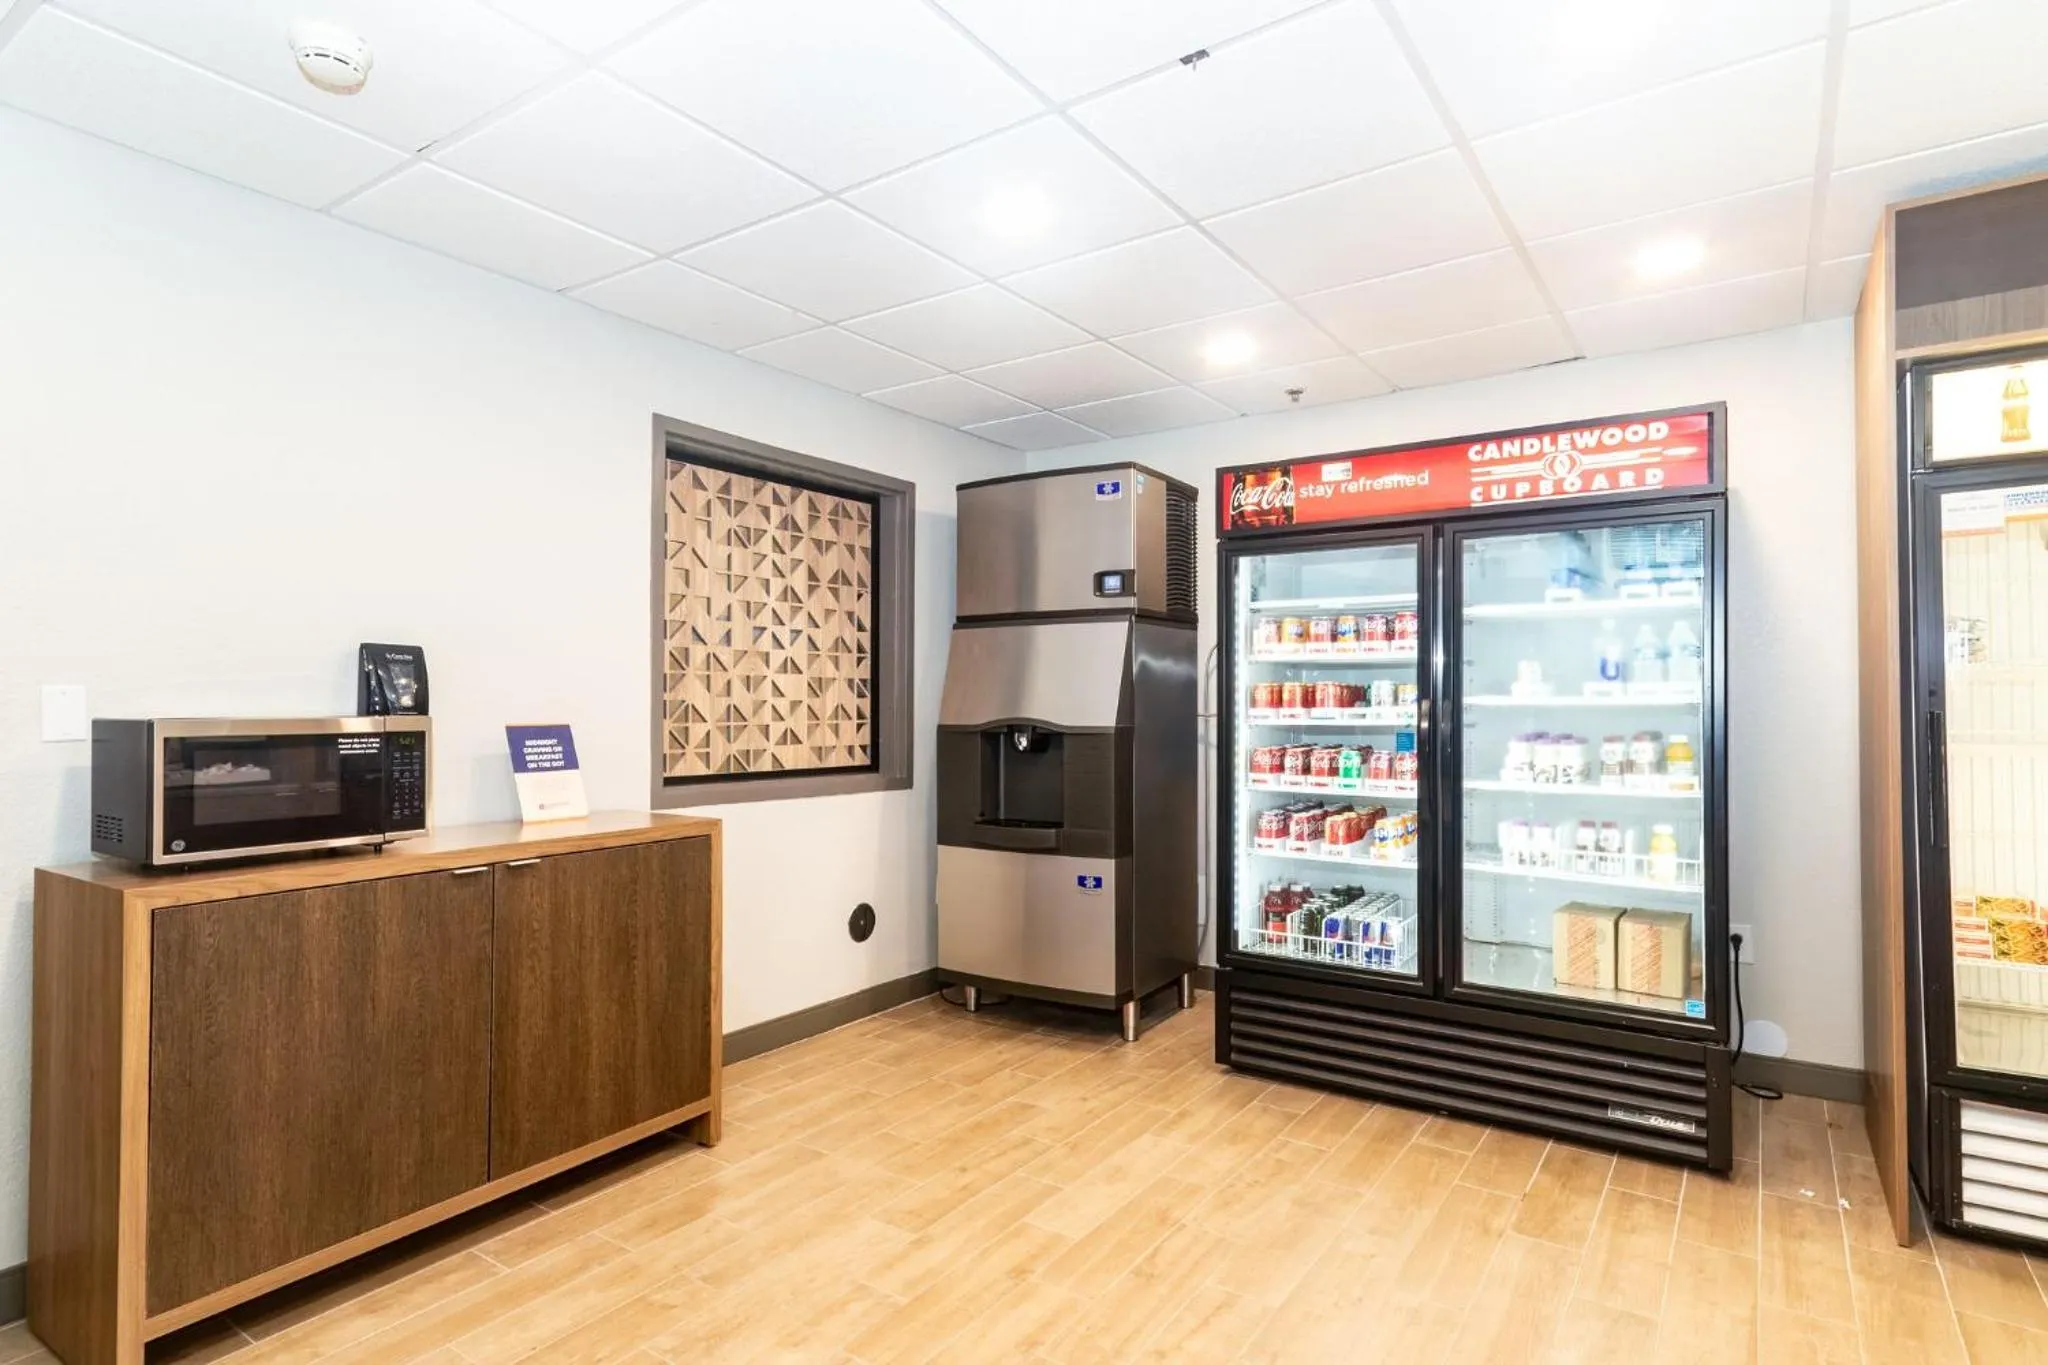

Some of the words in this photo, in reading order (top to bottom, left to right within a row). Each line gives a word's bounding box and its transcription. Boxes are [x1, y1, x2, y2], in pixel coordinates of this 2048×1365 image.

[1468, 421, 1669, 462] CANDLEWOOD
[1300, 483, 1334, 499] stay
[1341, 470, 1430, 494] refreshed
[1470, 468, 1665, 502] CUPBOARD
